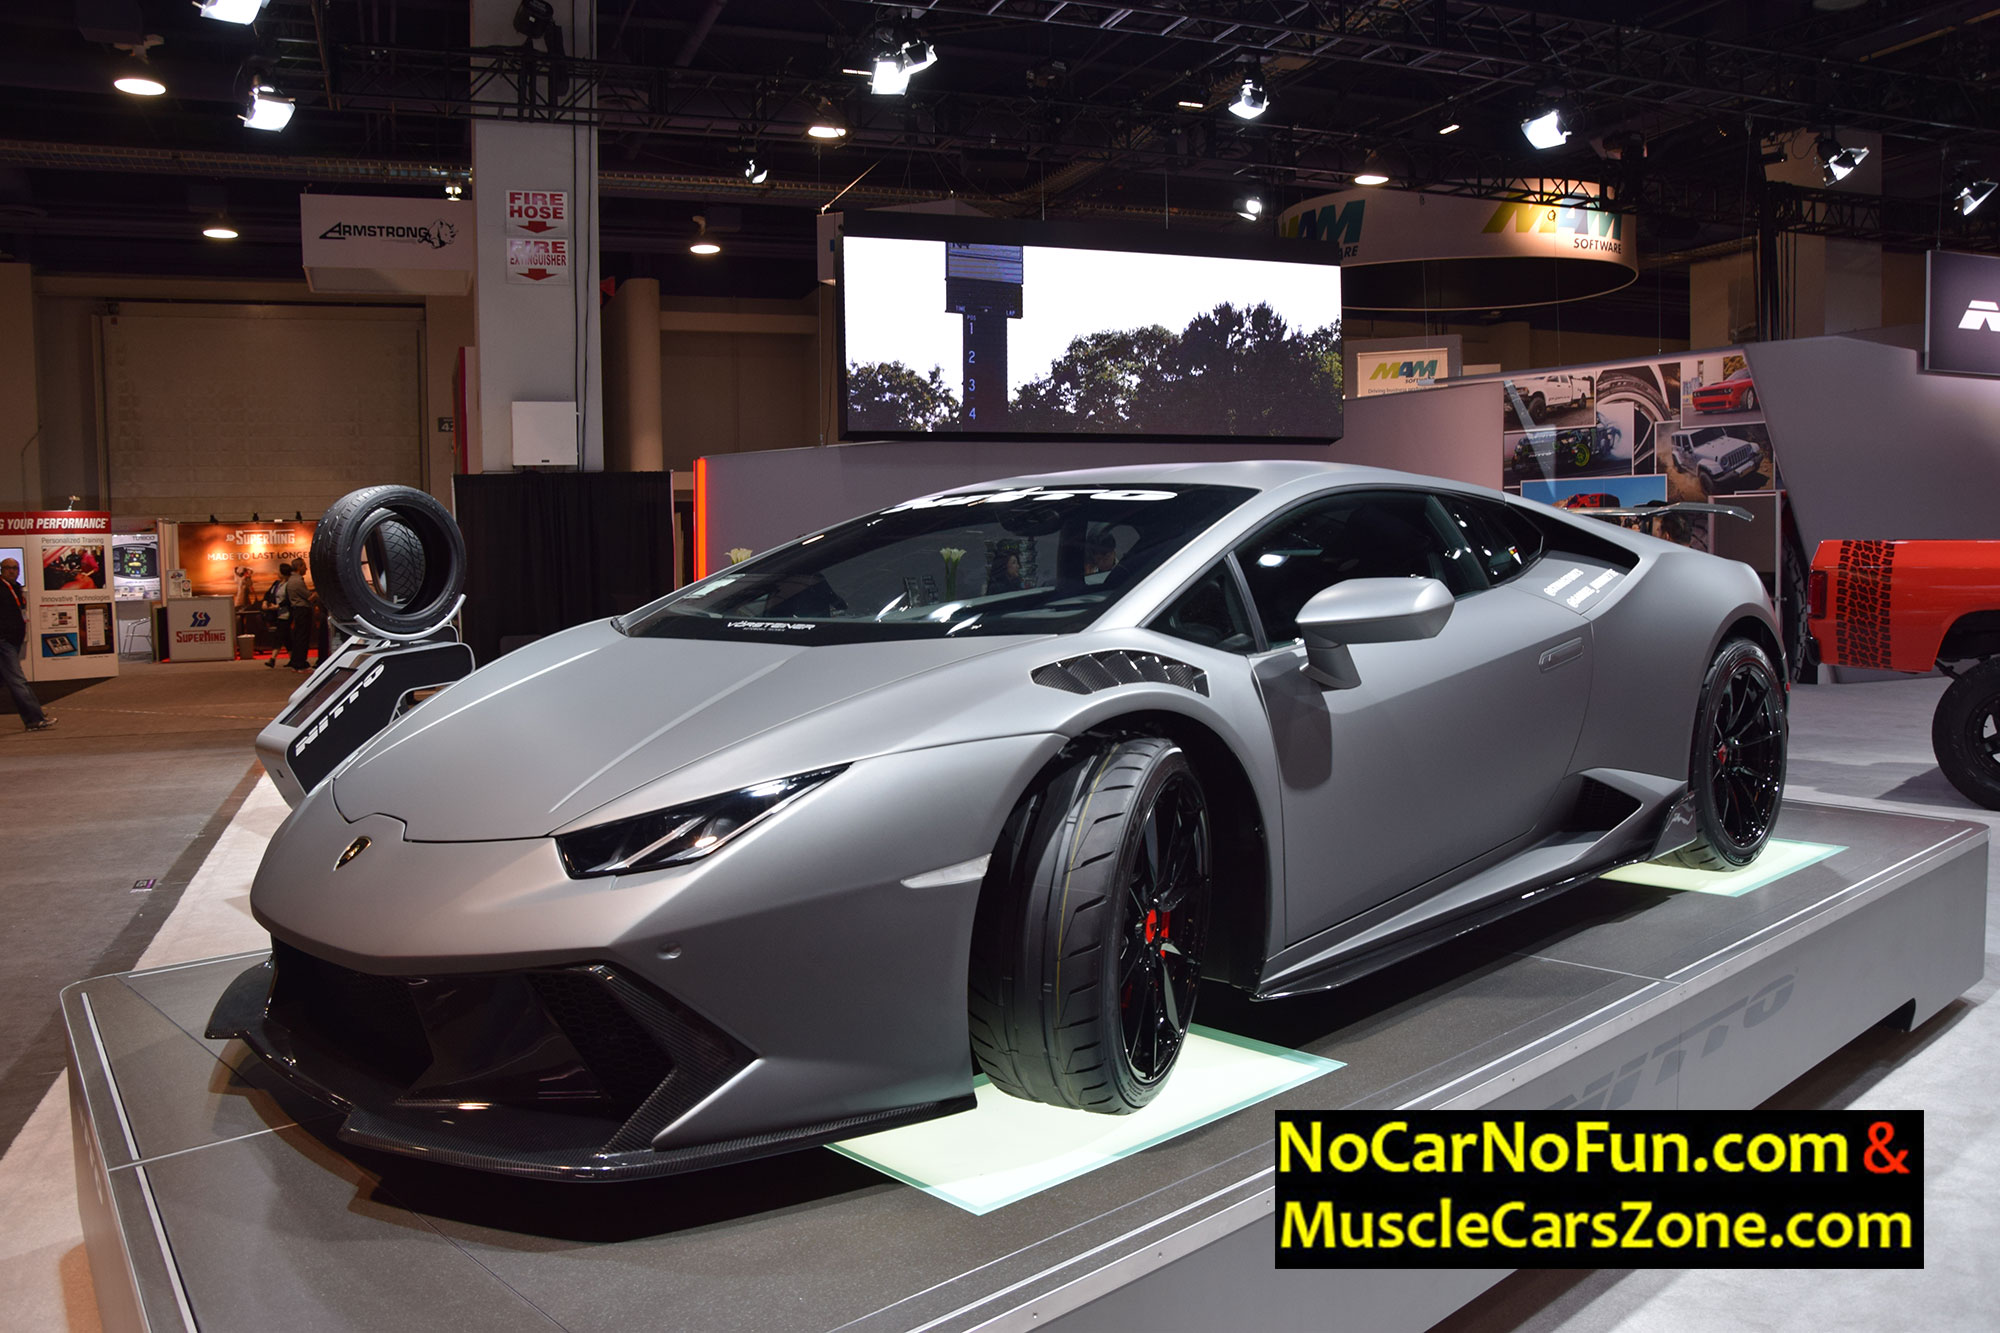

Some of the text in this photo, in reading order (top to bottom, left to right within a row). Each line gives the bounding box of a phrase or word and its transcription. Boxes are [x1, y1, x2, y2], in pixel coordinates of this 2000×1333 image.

[509, 192, 564, 206] FIRE
[509, 206, 564, 220] HOSE
[319, 222, 429, 240] ARMSTRONG
[510, 240, 567, 254] FIRE
[1573, 237, 1622, 255] SOFTWARE
[969, 322, 974, 335] 1
[968, 350, 976, 364] 2
[1369, 360, 1438, 380] MAM
[968, 378, 976, 392] 3
[968, 407, 976, 420] 4
[8, 519, 34, 530] YOUR
[207, 550, 311, 561] MADE TO LAST LONGE
[41, 595, 73, 603] Innovative
[295, 662, 385, 758] NITTO
